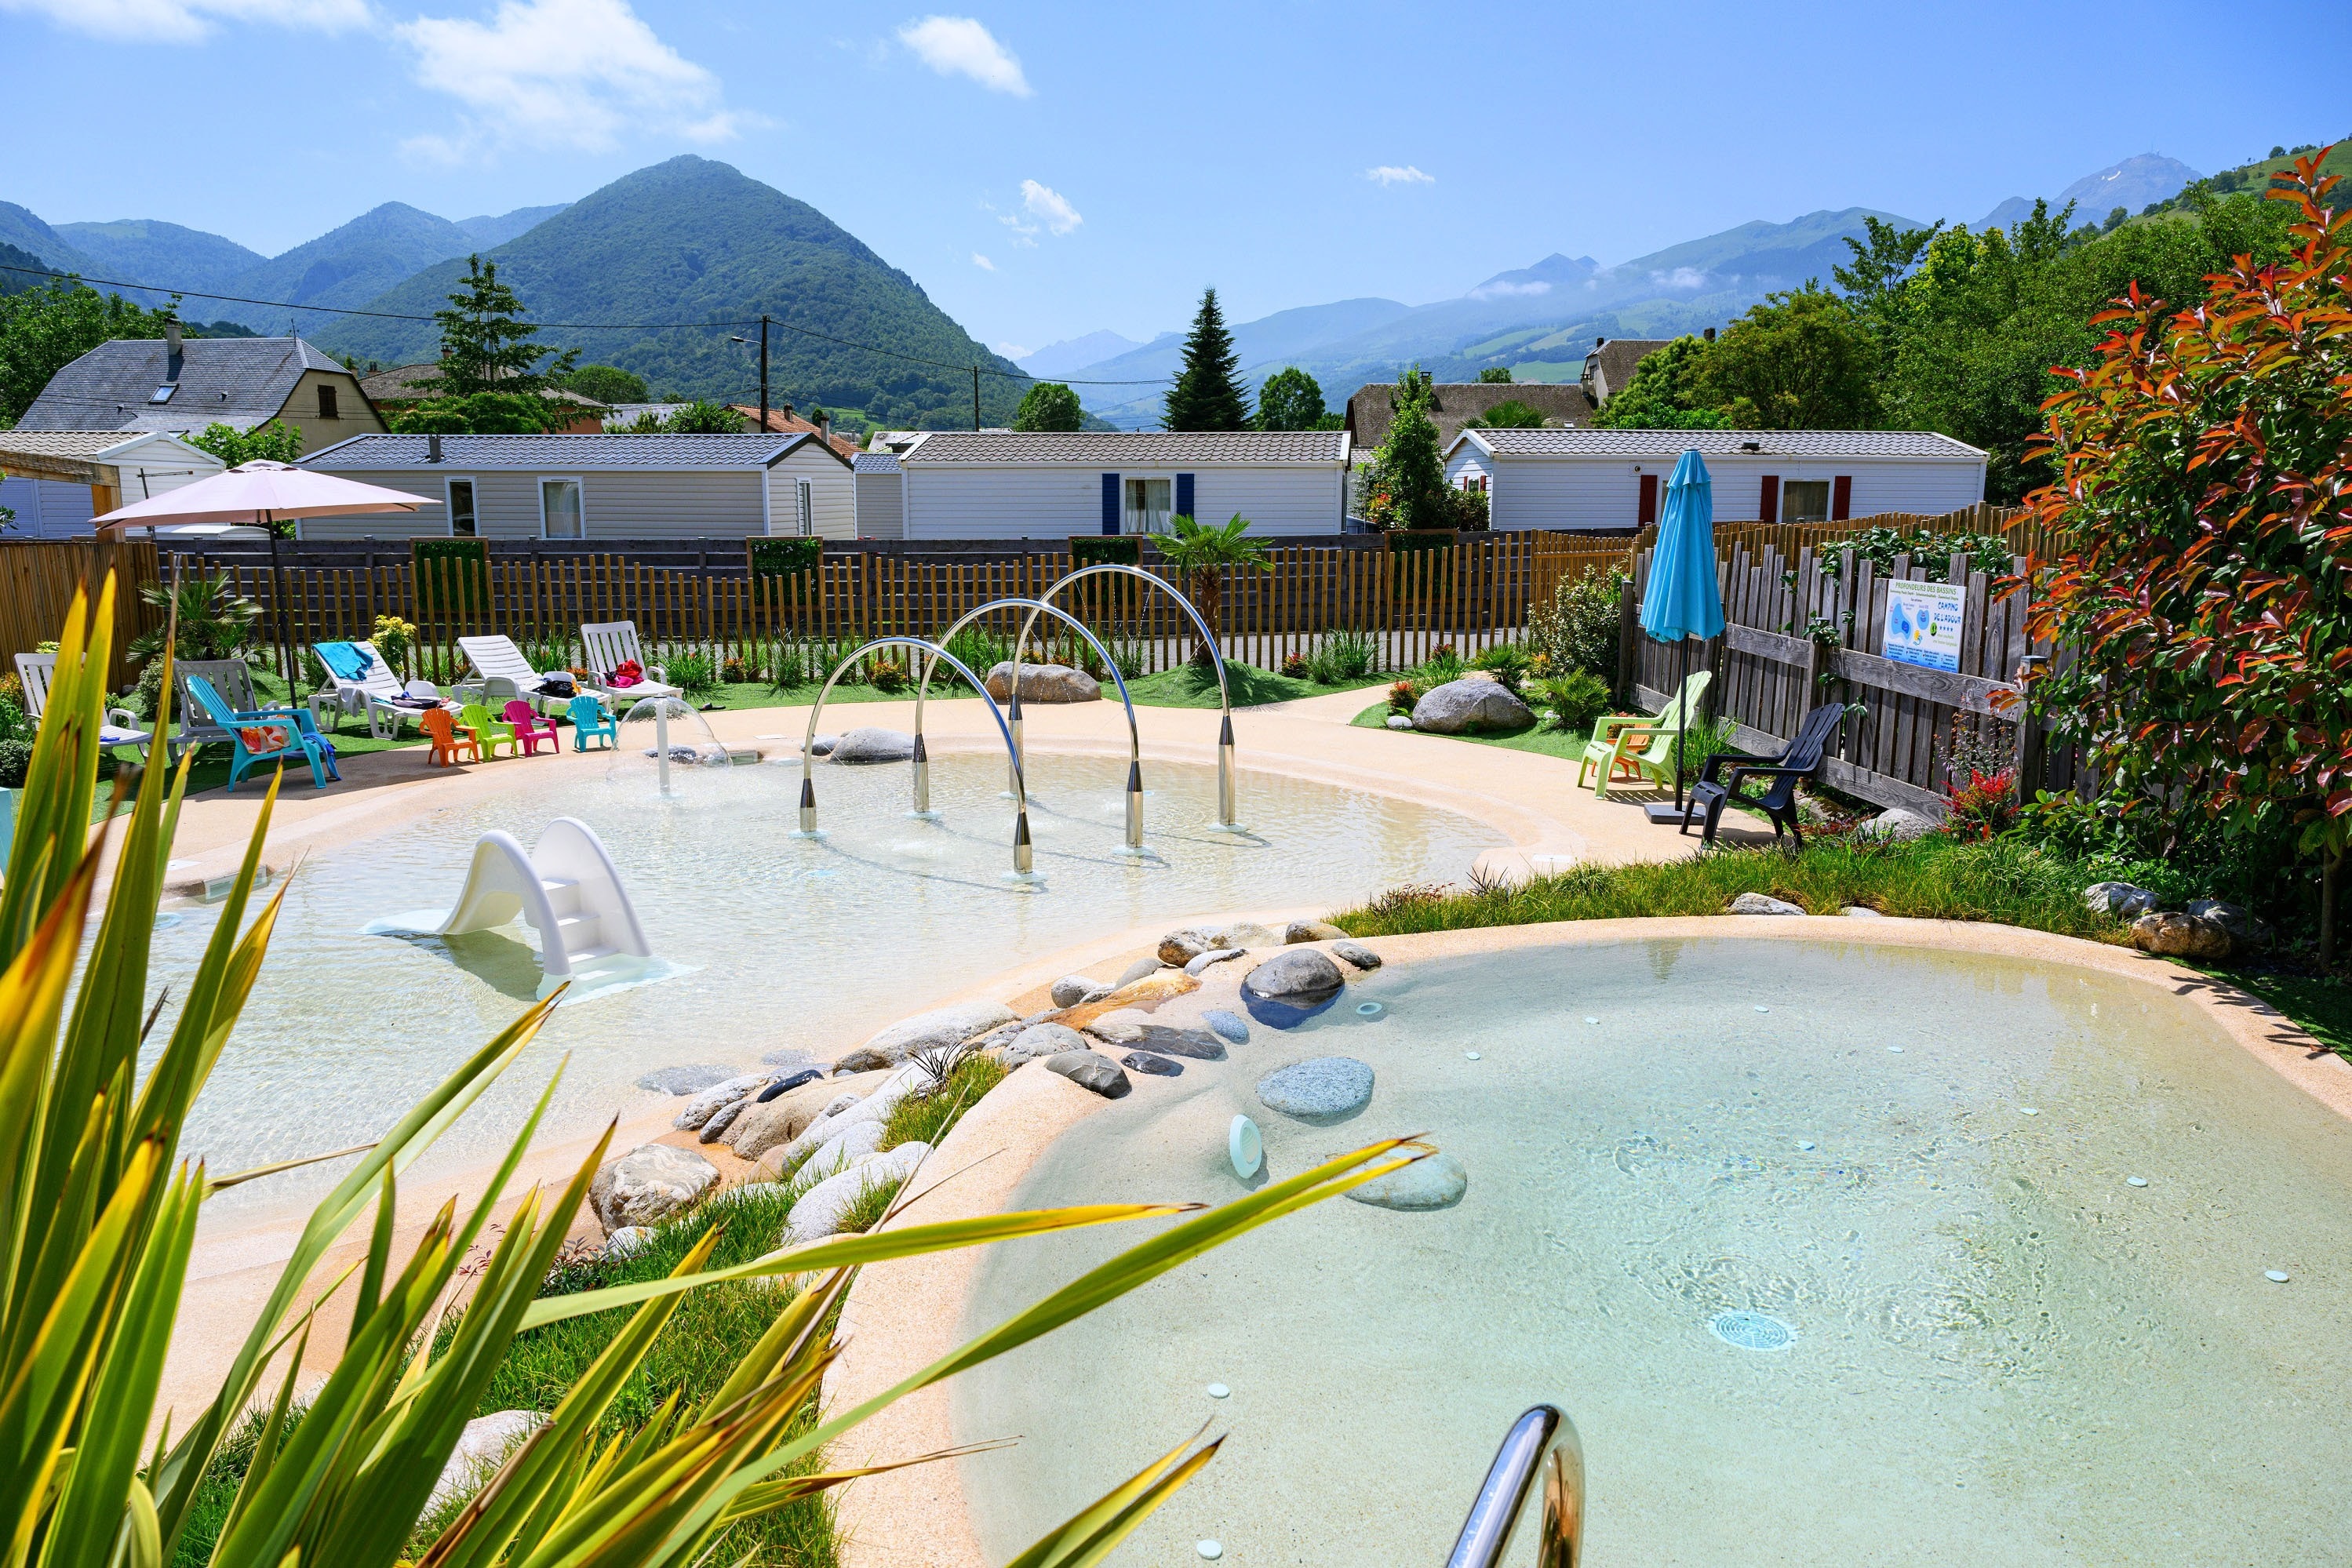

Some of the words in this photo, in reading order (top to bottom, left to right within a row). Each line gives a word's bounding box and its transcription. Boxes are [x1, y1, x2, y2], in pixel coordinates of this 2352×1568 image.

[1895, 582, 1926, 591] PROFONDEURS
[1936, 587, 1957, 595] BASSINS
[1938, 602, 1958, 612] CAMPING
[1934, 613, 1940, 621] DE
